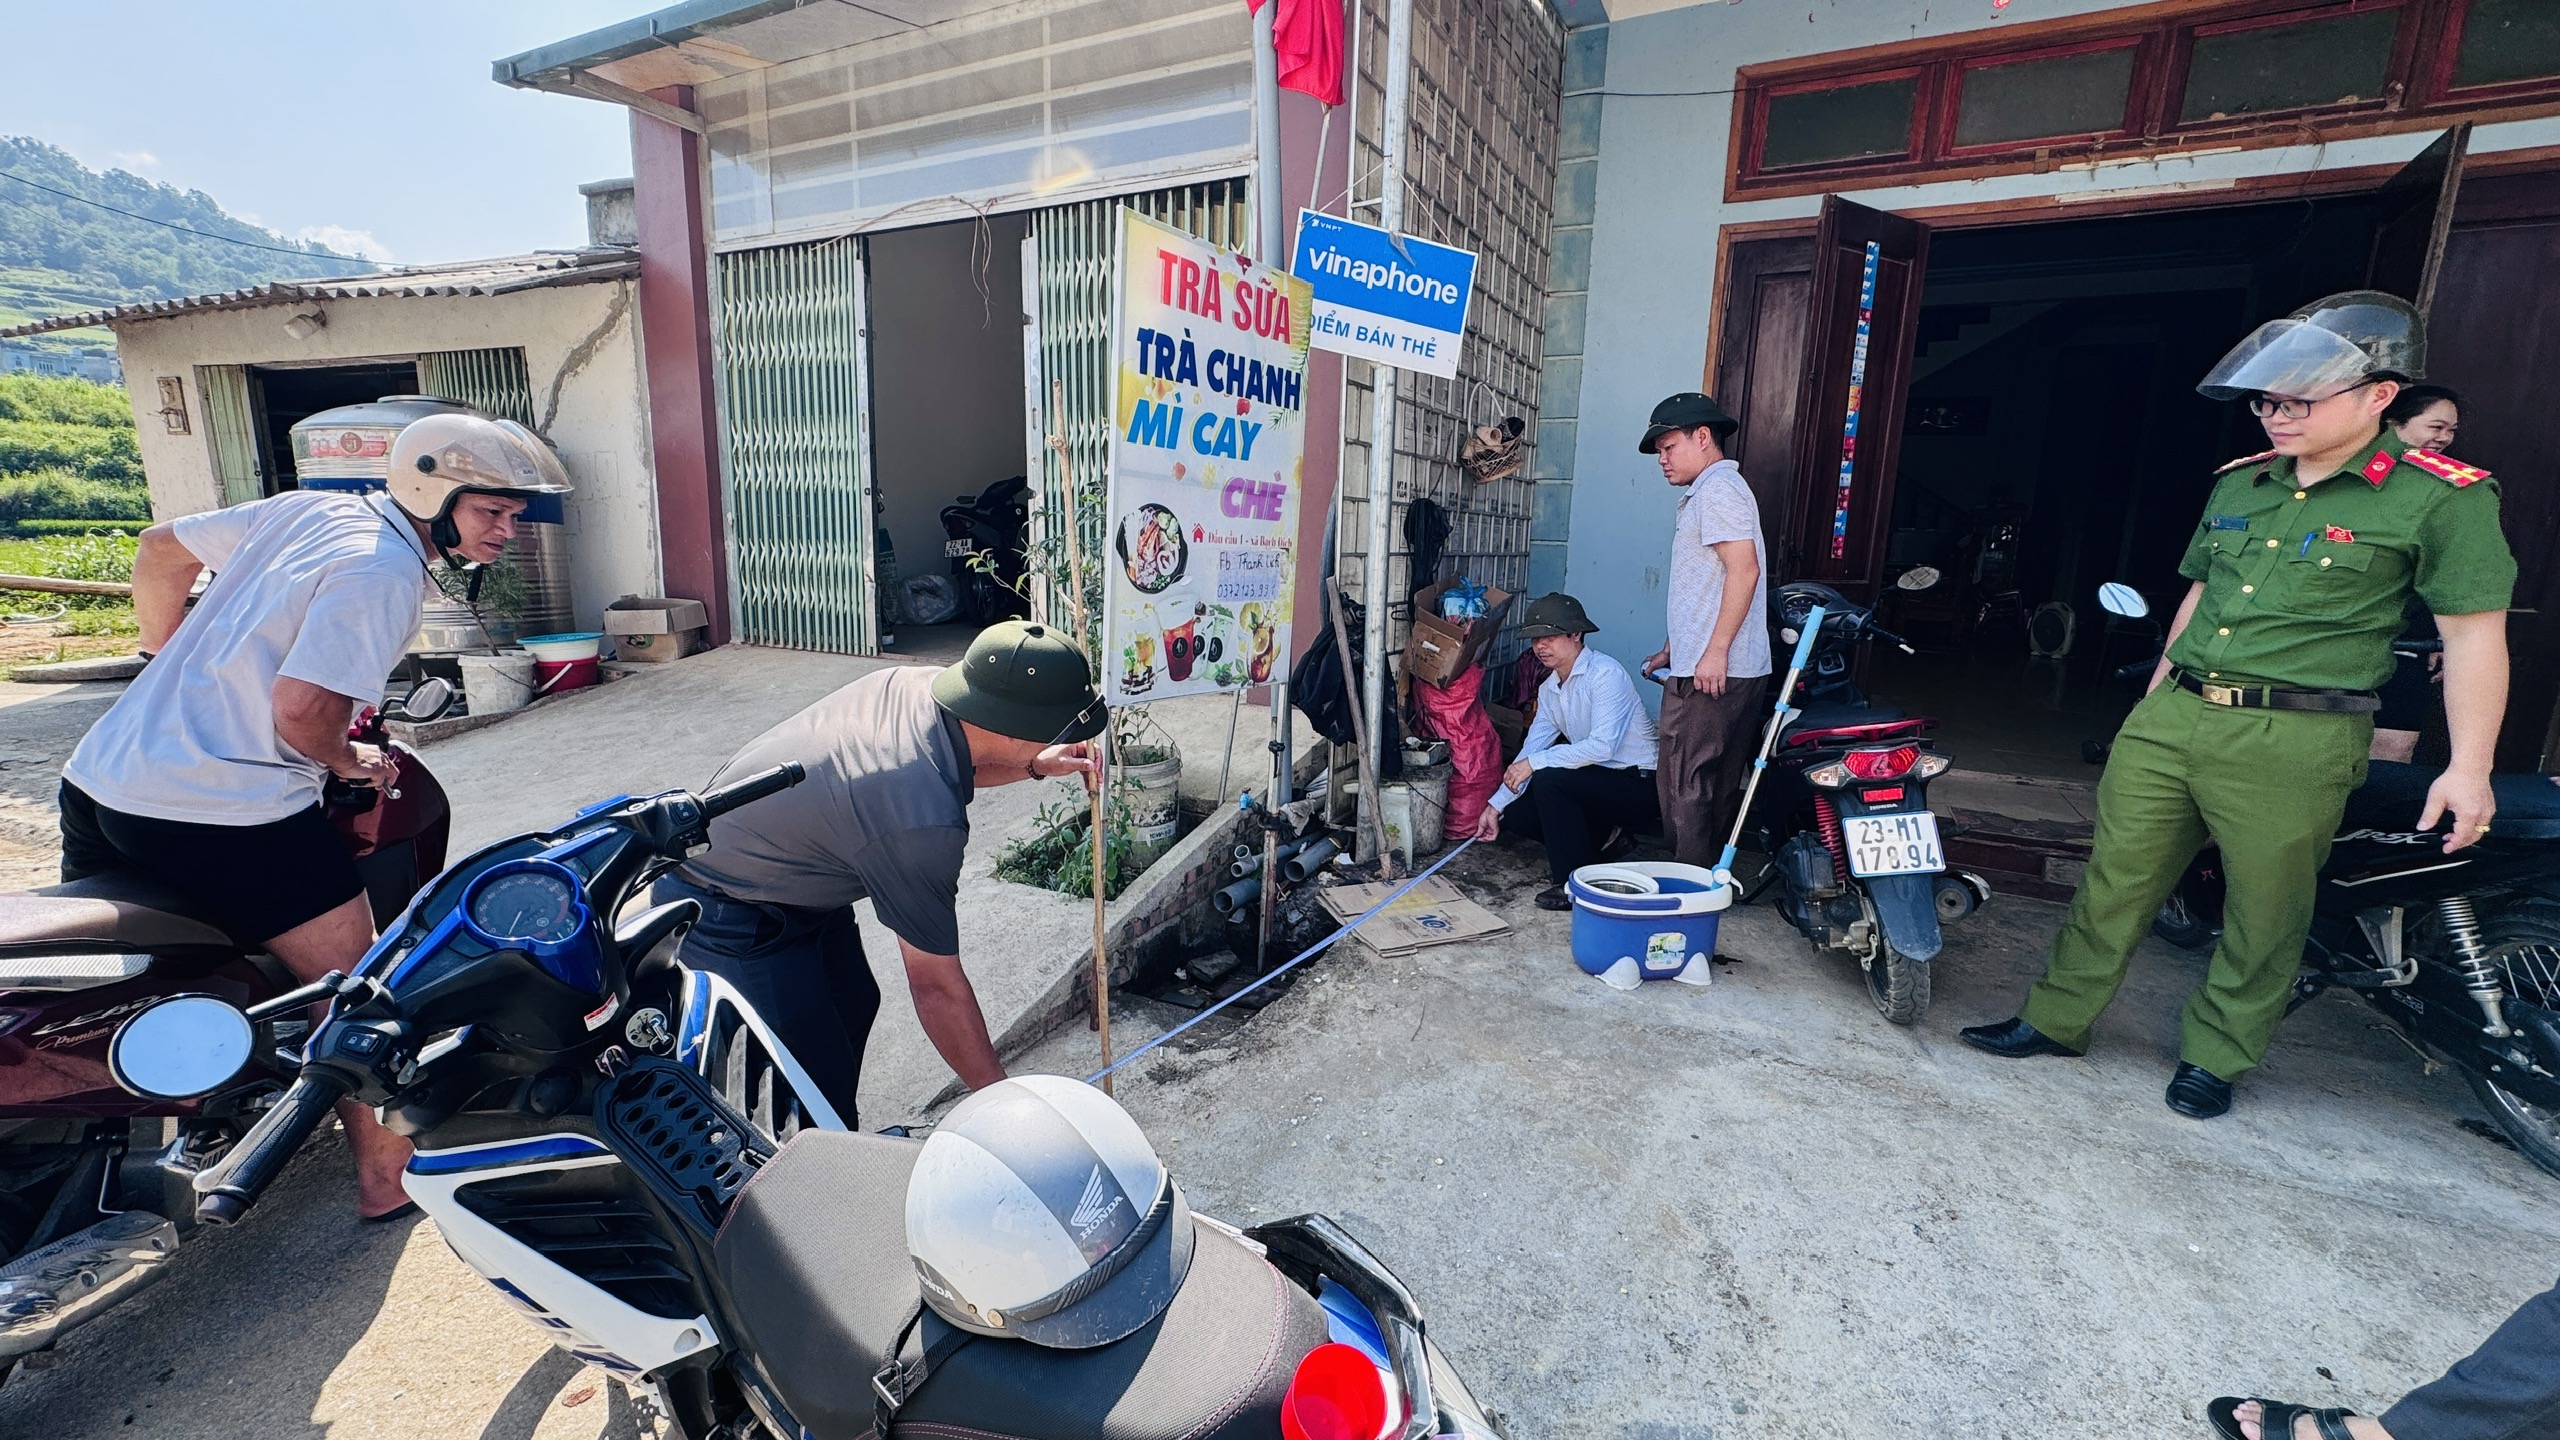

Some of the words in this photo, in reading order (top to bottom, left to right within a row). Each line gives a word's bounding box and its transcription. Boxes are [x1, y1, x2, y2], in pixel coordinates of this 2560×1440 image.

[1320, 222, 1343, 232] VNPT
[1158, 249, 1222, 324] TRÀ
[1234, 277, 1292, 345] SỮA
[1308, 245, 1459, 305] vinaphone
[1356, 323, 1394, 349] BÁN
[1401, 336, 1438, 359] THẺ
[1137, 327, 1198, 388] TRÀ
[1206, 349, 1301, 412] CHANH
[1126, 391, 1183, 450] MÌ
[1191, 411, 1263, 462] CAY
[1221, 471, 1287, 521] CHÈ
[1858, 817, 1922, 845] 23-M1
[1856, 843, 1938, 872] 178.94
[1080, 1195, 1123, 1240] HONDA
